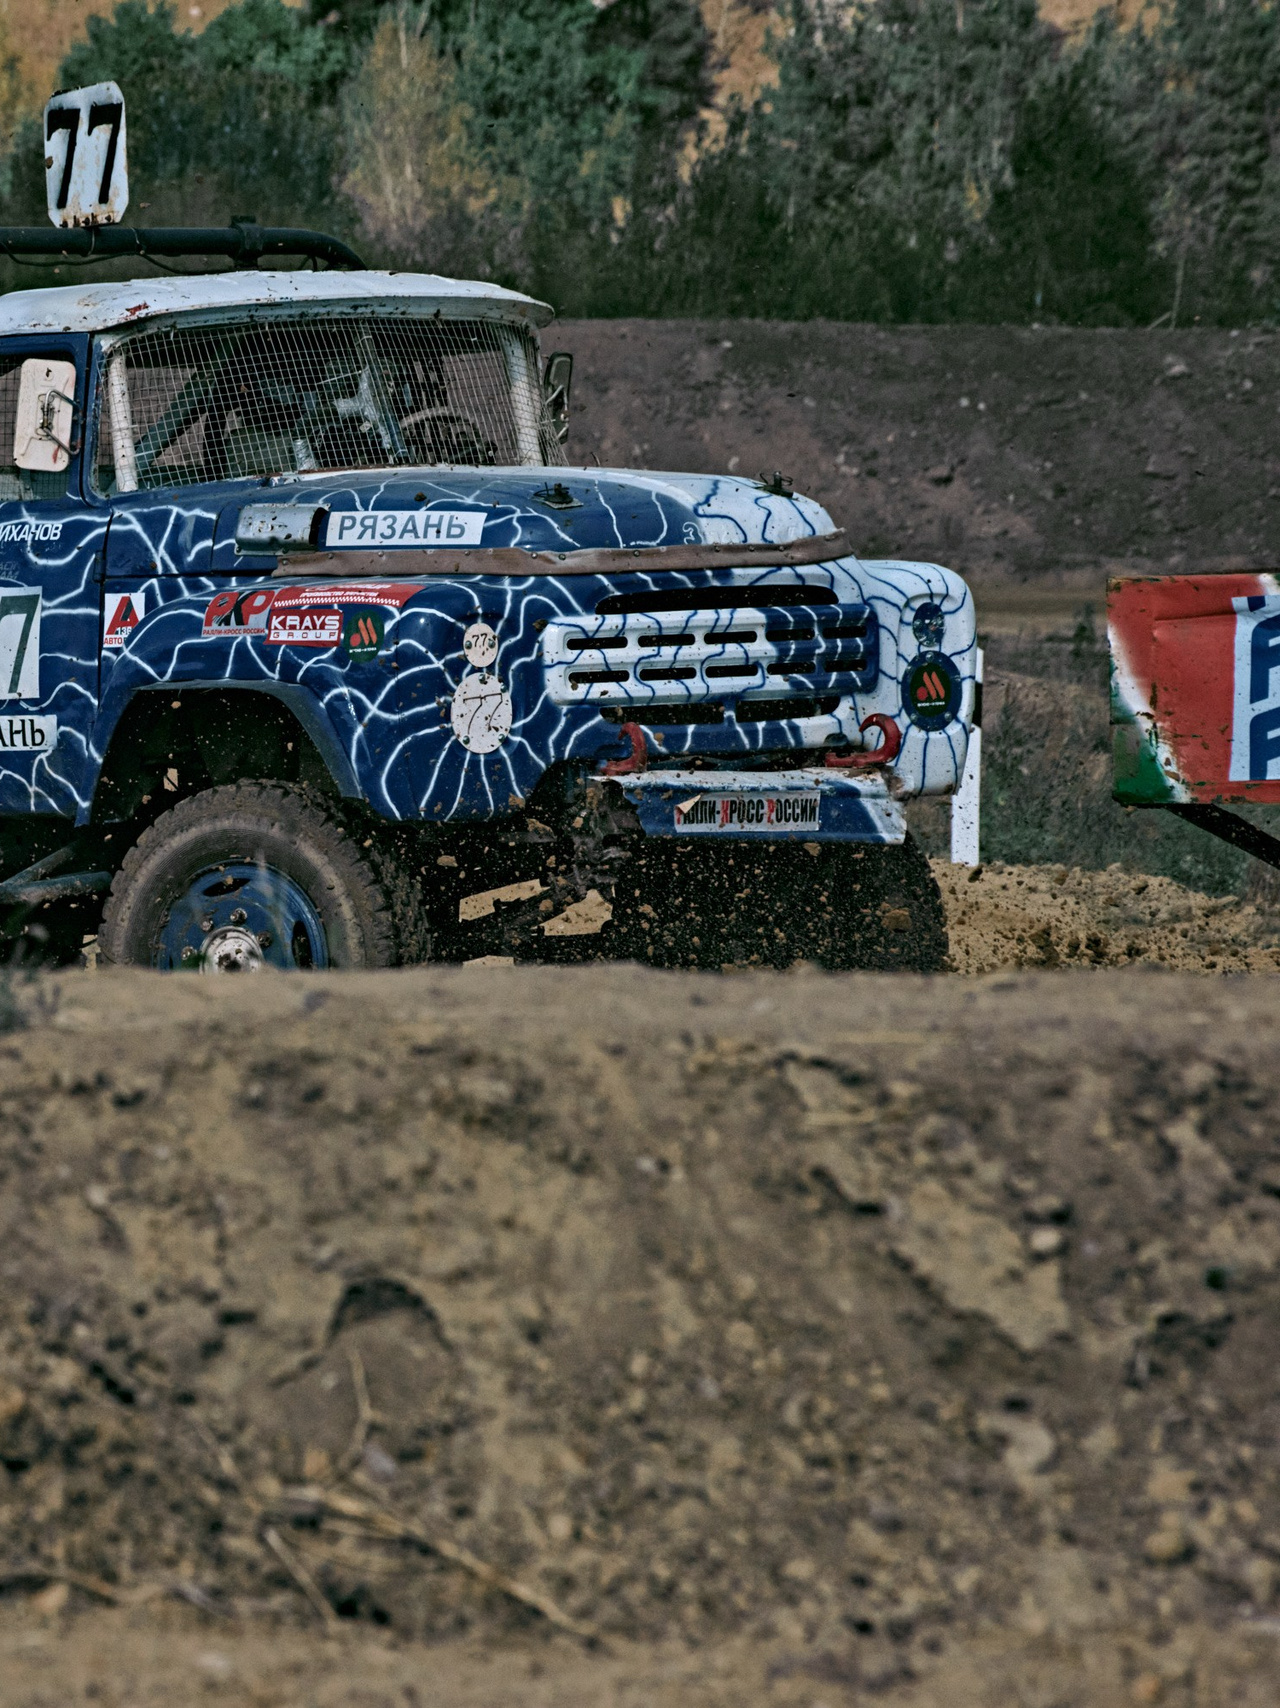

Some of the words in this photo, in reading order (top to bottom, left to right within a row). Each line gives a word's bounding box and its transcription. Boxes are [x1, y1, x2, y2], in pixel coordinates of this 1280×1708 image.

[47, 102, 123, 210] 77
[338, 514, 466, 540] РЯЗАНЬ
[271, 615, 340, 630] KRAYS
[273, 631, 337, 639] GROUP
[472, 633, 488, 647] 77
[767, 798, 818, 823] РОССИИ
